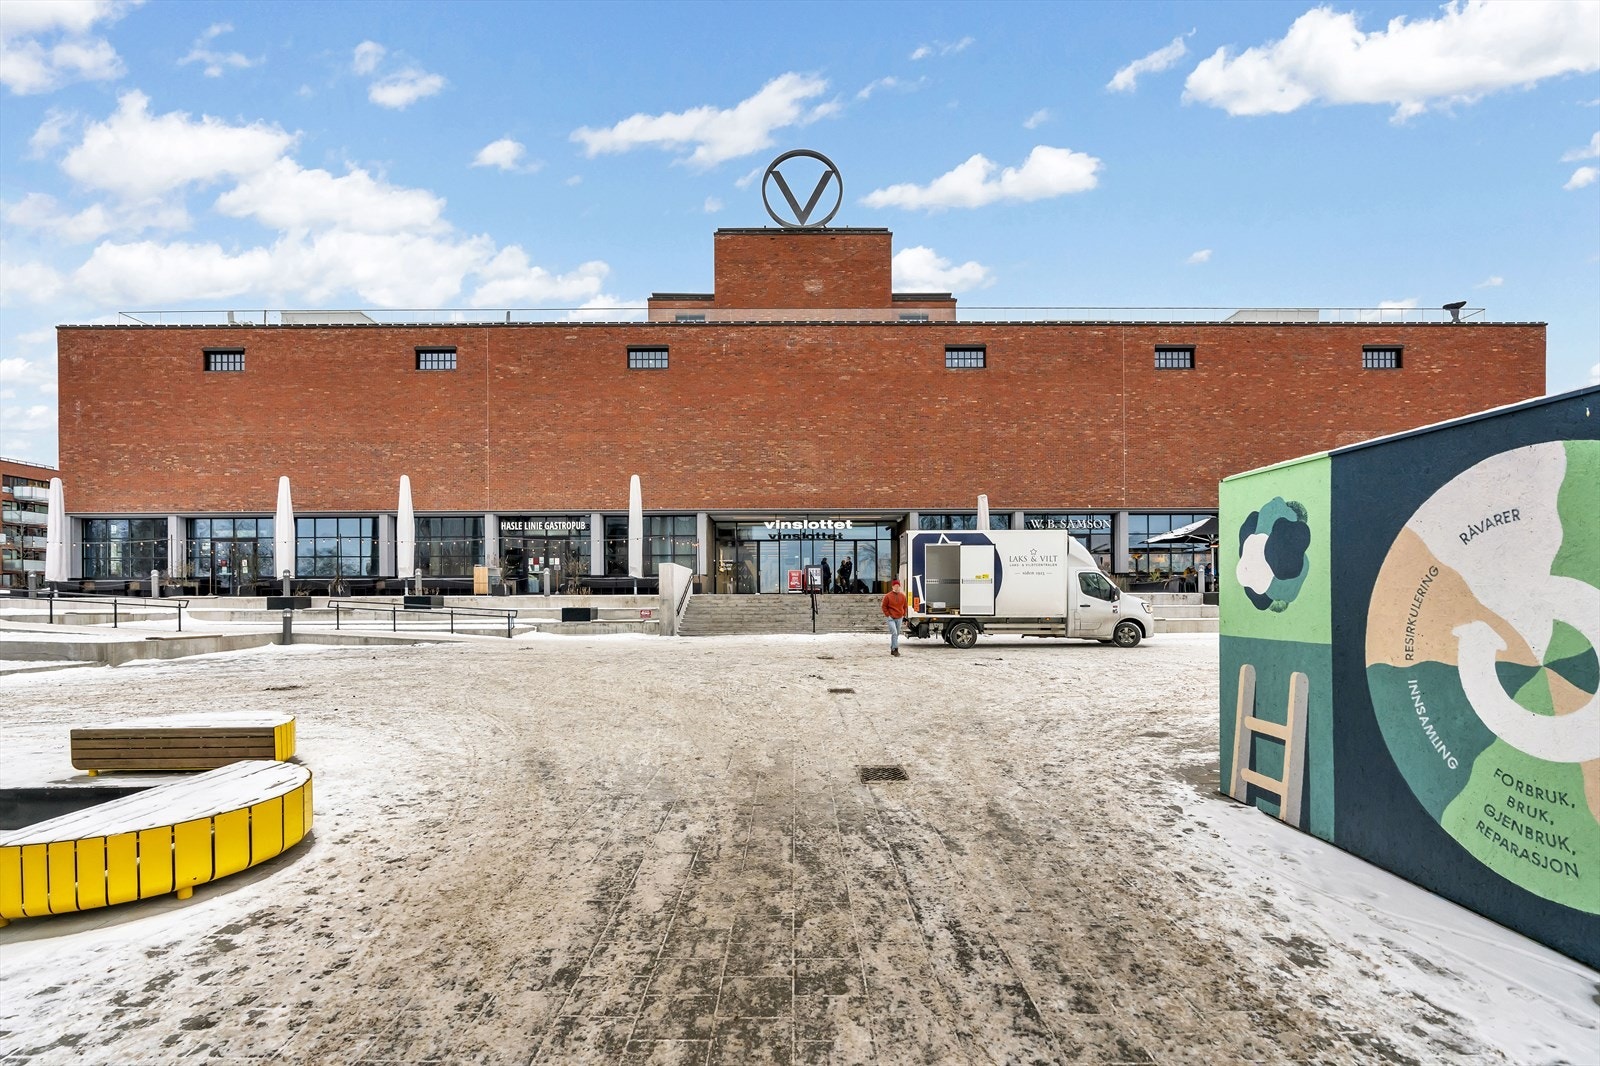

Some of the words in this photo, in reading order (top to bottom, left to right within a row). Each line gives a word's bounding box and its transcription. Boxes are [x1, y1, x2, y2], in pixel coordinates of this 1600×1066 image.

[770, 171, 835, 226] V
[501, 521, 523, 530] HASLE
[524, 521, 543, 530] LINIE
[544, 521, 585, 530] GASTROPUB
[764, 519, 852, 529] vinslottet
[1030, 519, 1044, 529] W.
[1047, 519, 1057, 529] B.
[1060, 519, 1111, 529] SAMSON
[1459, 508, 1521, 546] RÅVARER
[1405, 565, 1439, 661] RESIRKULERING
[1407, 679, 1458, 770] INNSAMLING
[1493, 768, 1576, 809] FORBRUK,
[1483, 803, 1576, 856] GJENBRUK,
[1507, 795, 1554, 825] BRUK,
[1475, 820, 1579, 879] REPARASJON
